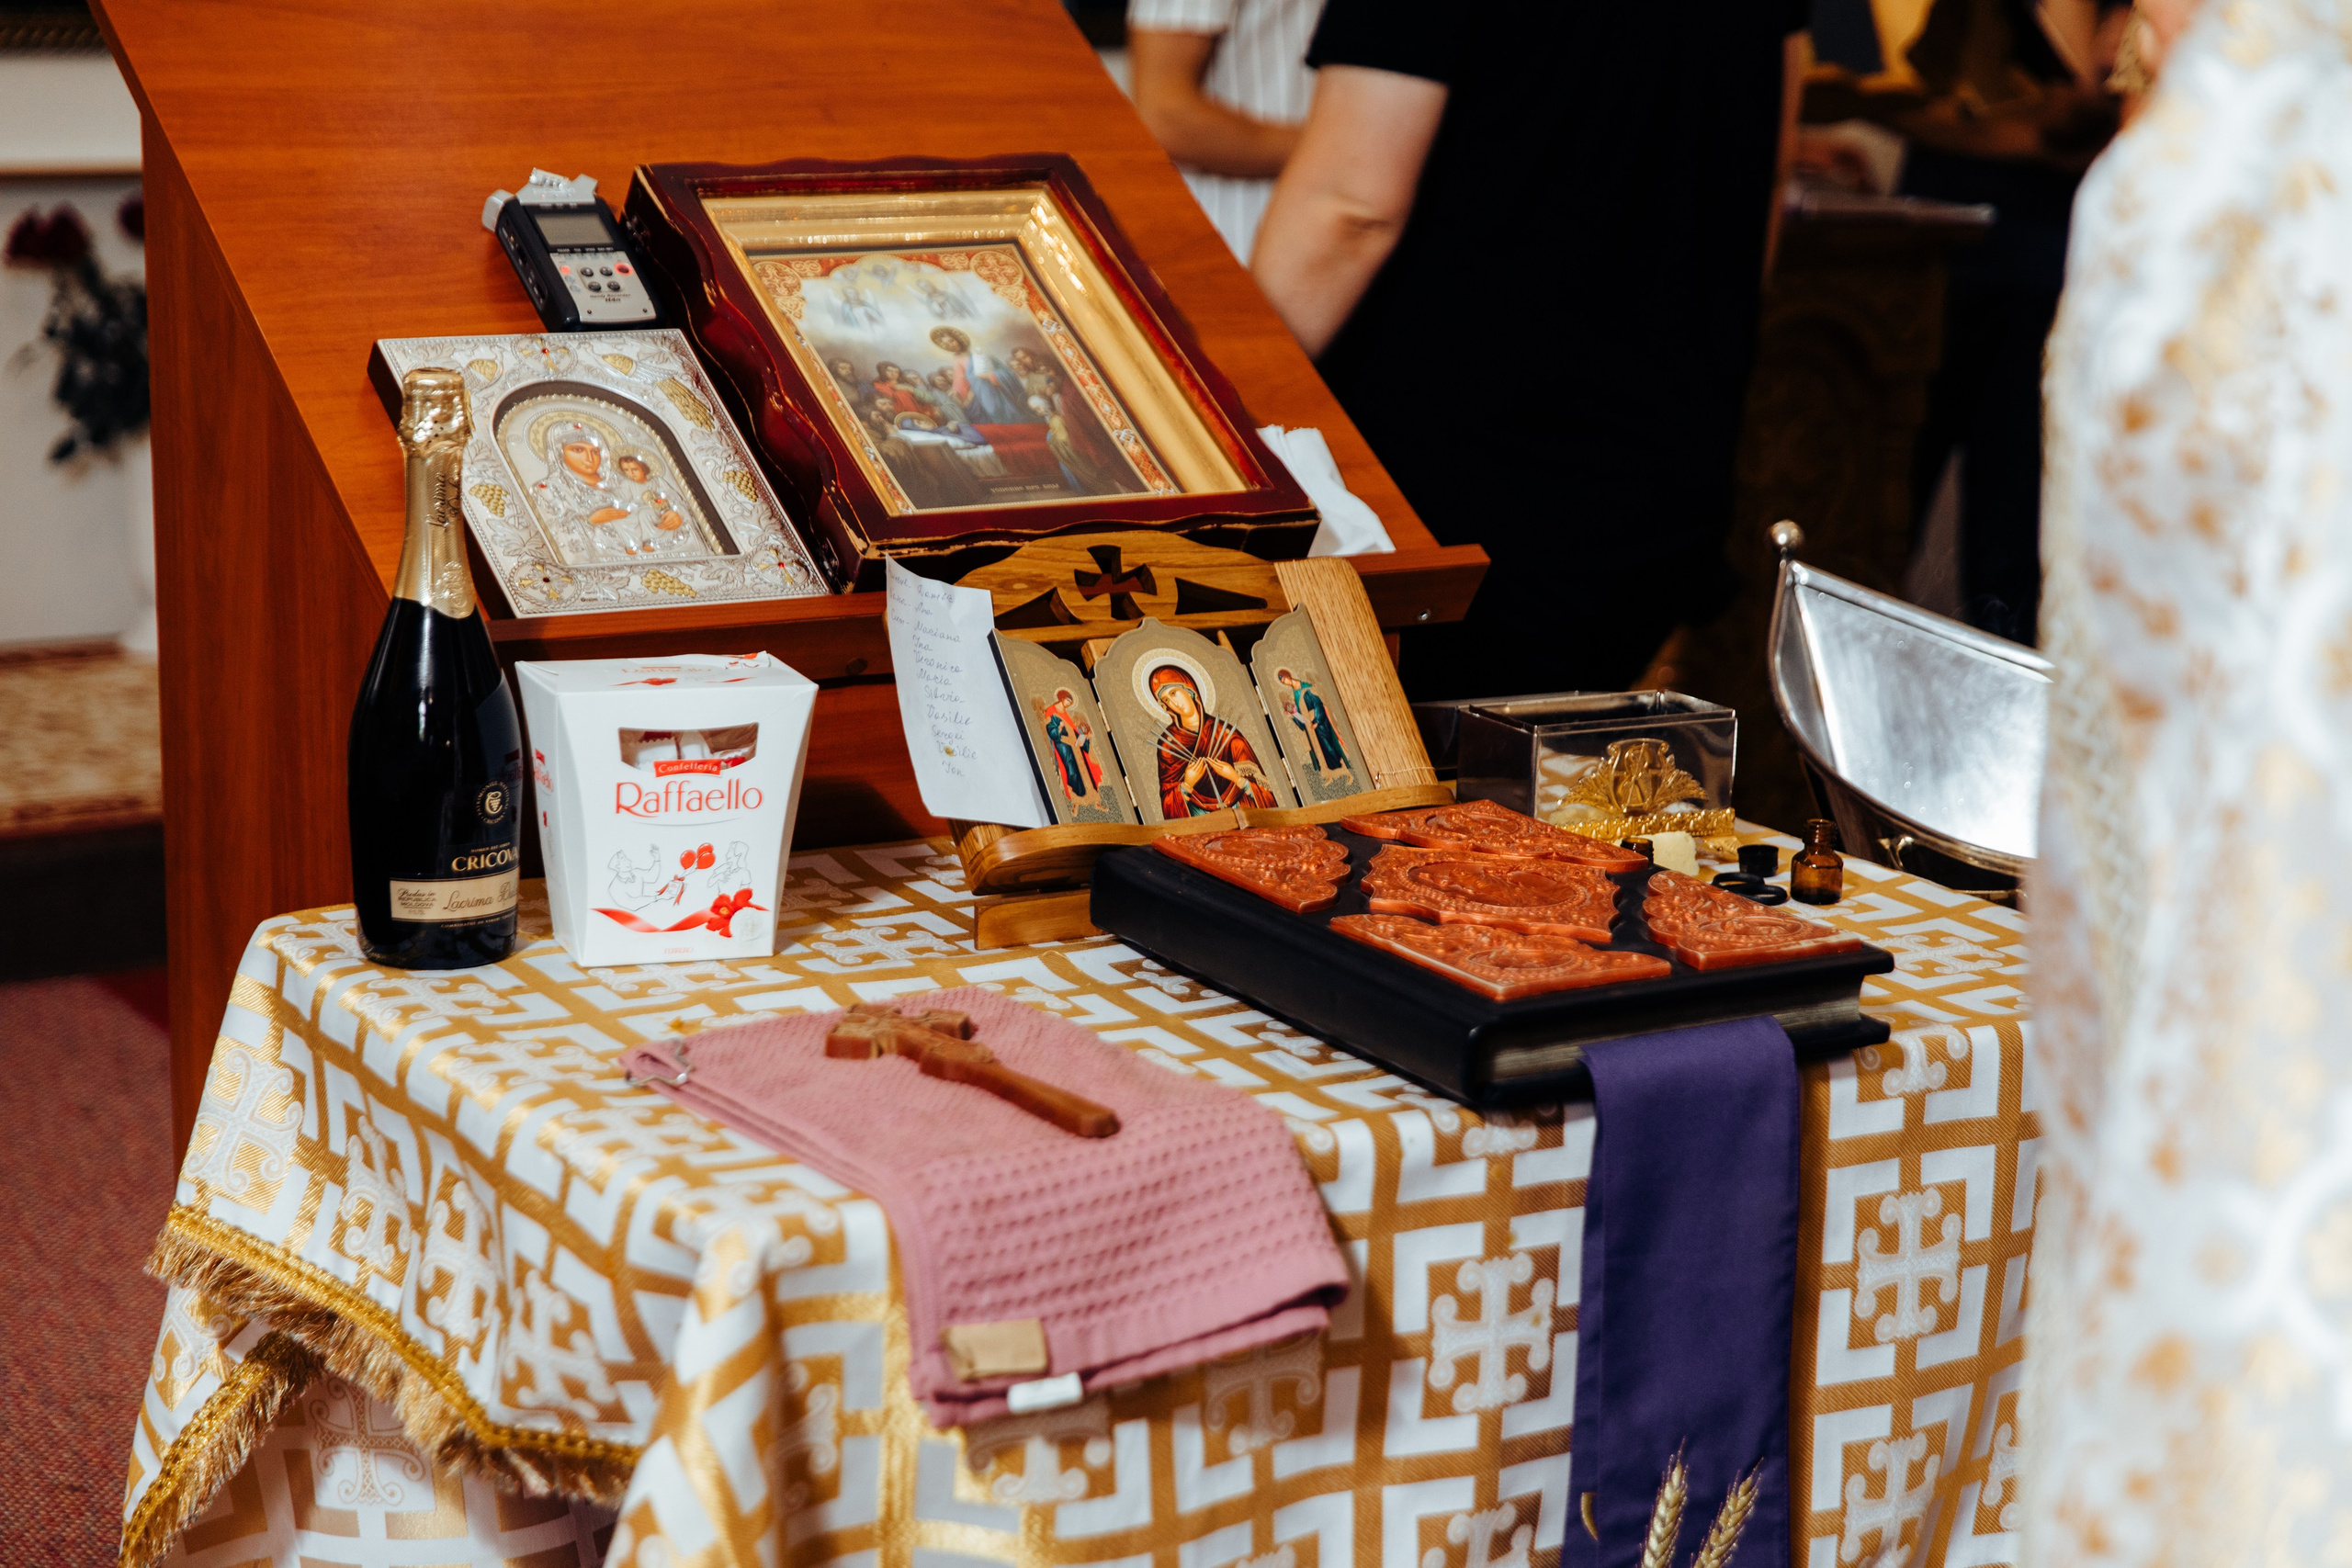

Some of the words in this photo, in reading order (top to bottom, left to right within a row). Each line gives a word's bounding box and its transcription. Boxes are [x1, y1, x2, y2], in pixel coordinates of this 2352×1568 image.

[658, 761, 718, 773] Confetteria
[615, 778, 763, 818] Raffaello
[451, 846, 518, 872] CRICOVA
[443, 889, 494, 912] Lacrima
